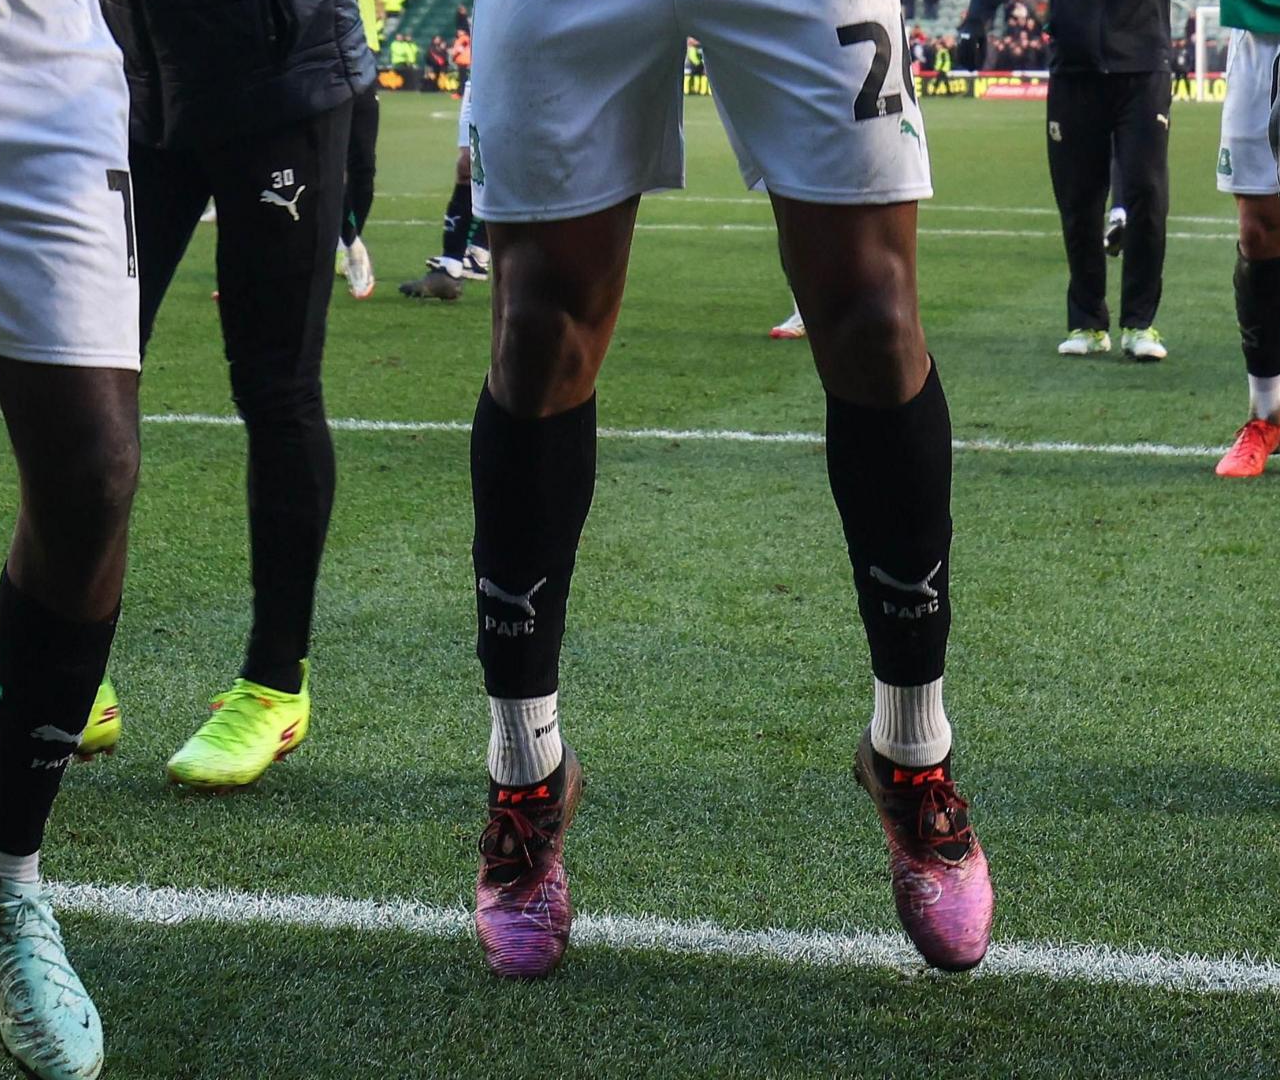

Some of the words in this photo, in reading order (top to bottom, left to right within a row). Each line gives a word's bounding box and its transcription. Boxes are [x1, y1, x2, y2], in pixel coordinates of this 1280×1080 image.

[271, 168, 295, 189] 30
[882, 598, 939, 619] PAFC
[485, 614, 535, 637] PAFC
